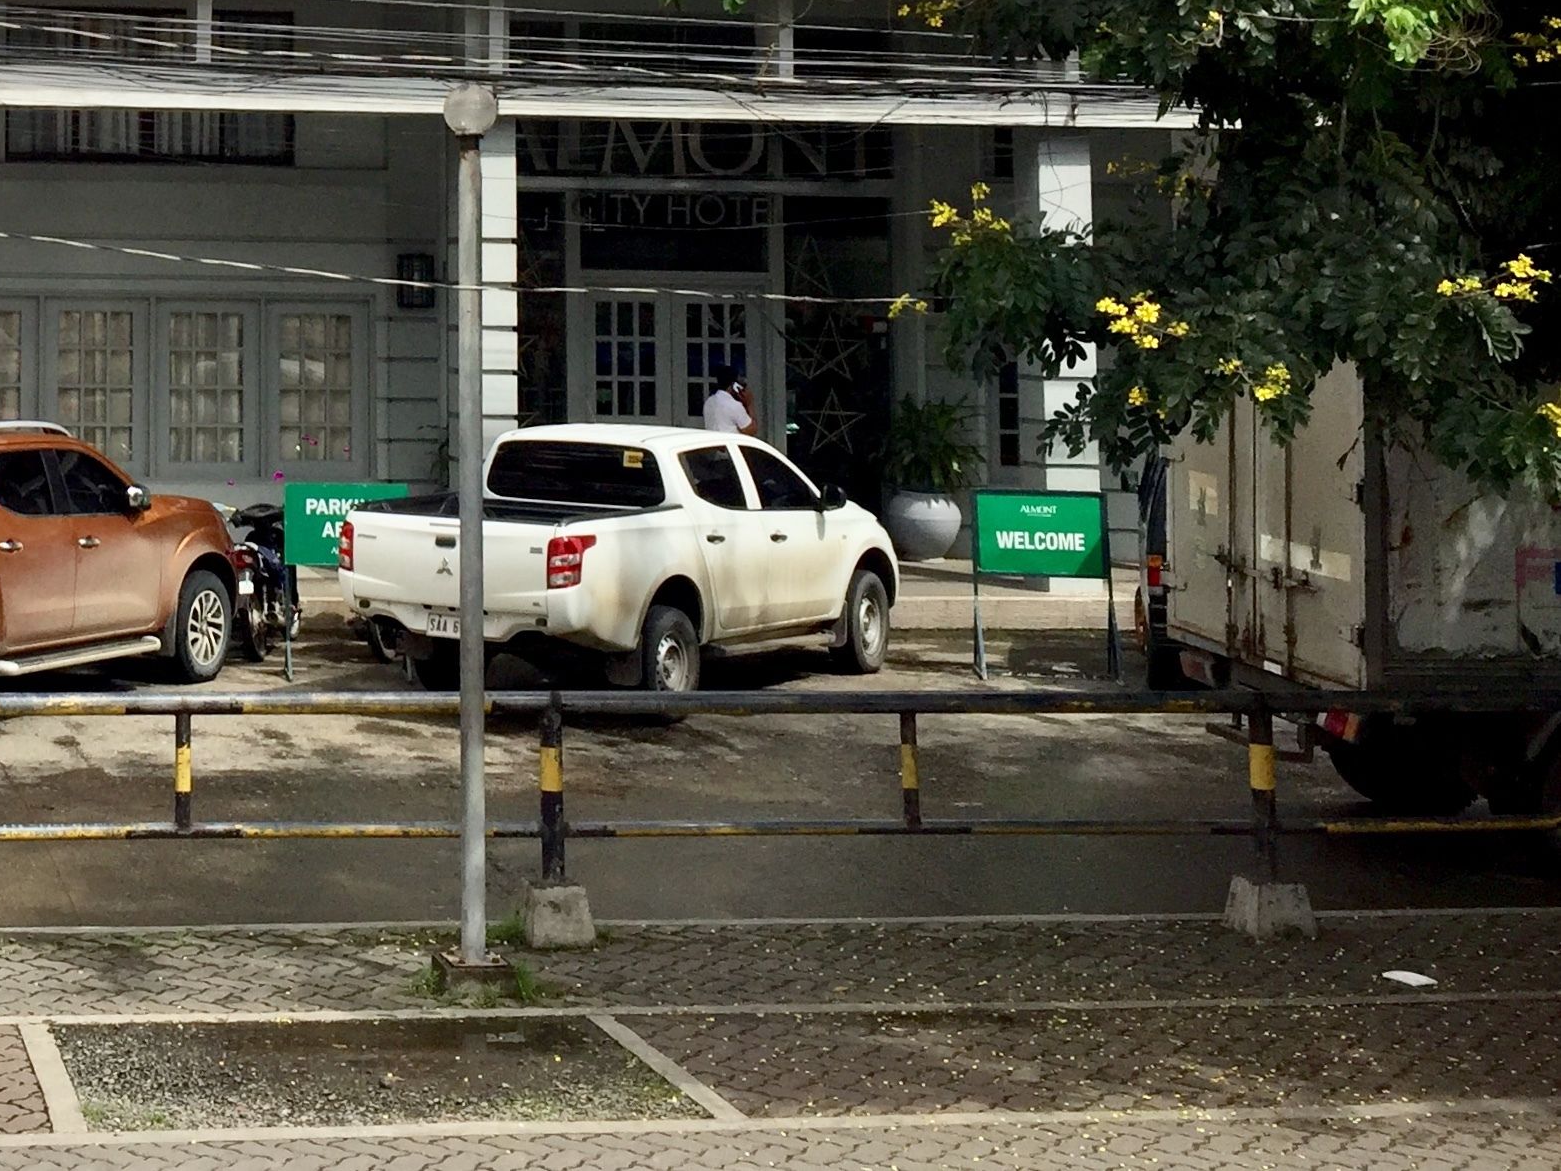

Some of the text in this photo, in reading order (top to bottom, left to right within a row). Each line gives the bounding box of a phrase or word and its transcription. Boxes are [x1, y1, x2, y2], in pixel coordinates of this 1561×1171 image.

[666, 194, 772, 225] HOTE
[305, 498, 367, 515] PARK
[1019, 504, 1057, 515] ALMONT
[996, 531, 1086, 551] WELCOME
